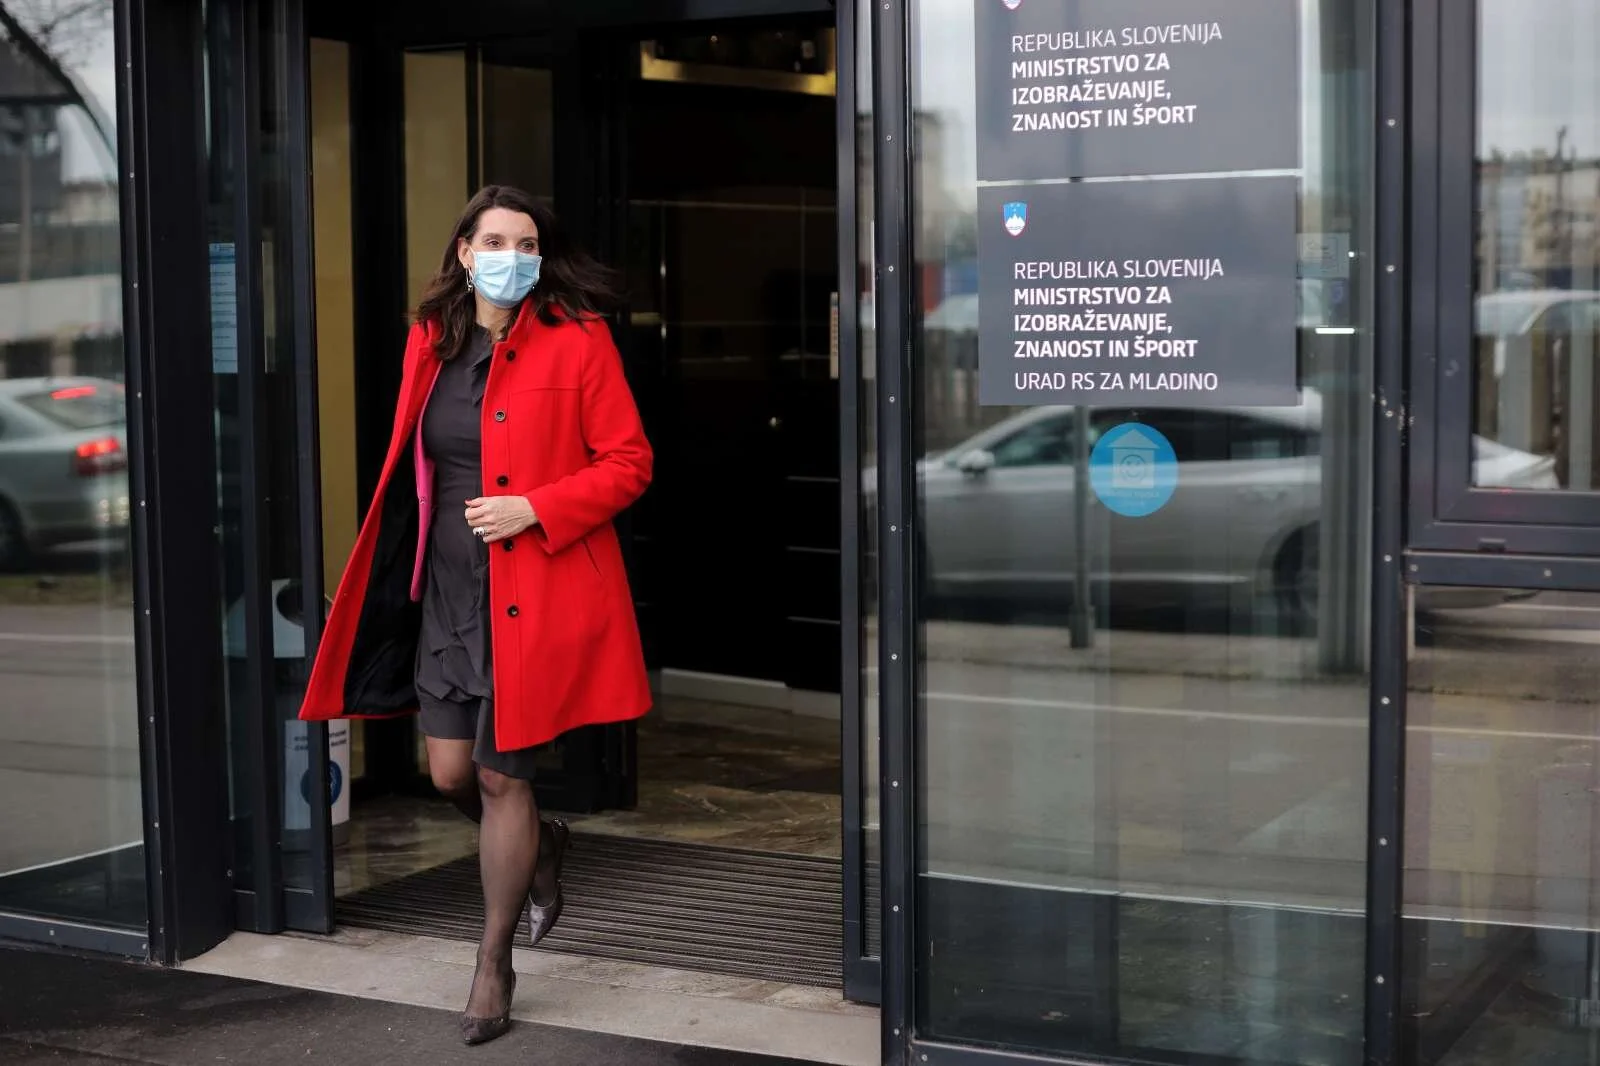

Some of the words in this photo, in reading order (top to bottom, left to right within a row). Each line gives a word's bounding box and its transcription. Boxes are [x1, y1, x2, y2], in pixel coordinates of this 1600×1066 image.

[1012, 29, 1116, 52] REPUBLIKA
[1121, 23, 1222, 46] SLOVENIJA
[1012, 54, 1139, 79] MINISTRSTVO
[1144, 53, 1170, 71] ZA
[1012, 79, 1171, 105] IZOBRAŽEVANJE,
[1012, 109, 1103, 131] ZNANOST
[1108, 108, 1128, 127] IN
[1133, 103, 1197, 126] ŠPORT
[1014, 260, 1118, 280] REPUBLIKA
[1123, 258, 1224, 280] SLOVENIJA
[1014, 286, 1141, 305] MINISTRSTVO
[1146, 286, 1172, 304] ZA
[1014, 309, 1173, 334] IZOBRAŽEVANJE,
[1014, 339, 1104, 358] ZNANOST
[1109, 339, 1128, 358] IN
[1134, 335, 1198, 358] ŠPORT
[1015, 372, 1066, 391] URAD
[1072, 372, 1095, 391] RS
[1100, 372, 1124, 391] ZA
[1130, 372, 1218, 391] MLADINO
